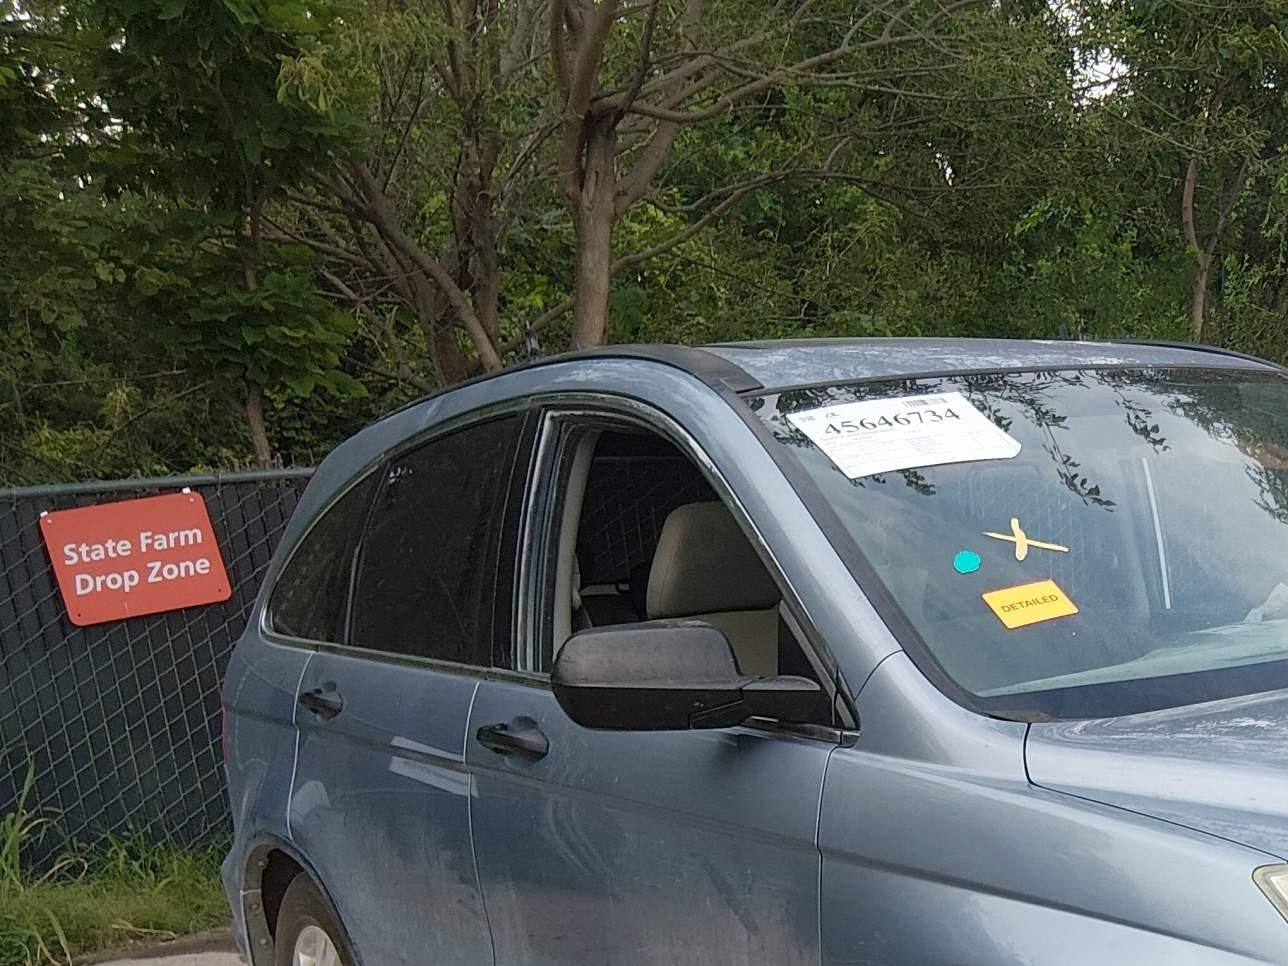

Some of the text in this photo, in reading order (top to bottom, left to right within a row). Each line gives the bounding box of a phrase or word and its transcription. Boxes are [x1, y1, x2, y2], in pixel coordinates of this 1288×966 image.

[824, 407, 961, 436] 45646734
[63, 527, 202, 566] State Farm
[75, 557, 211, 596] Drop Zone
[1000, 594, 1059, 613] DETAILED
